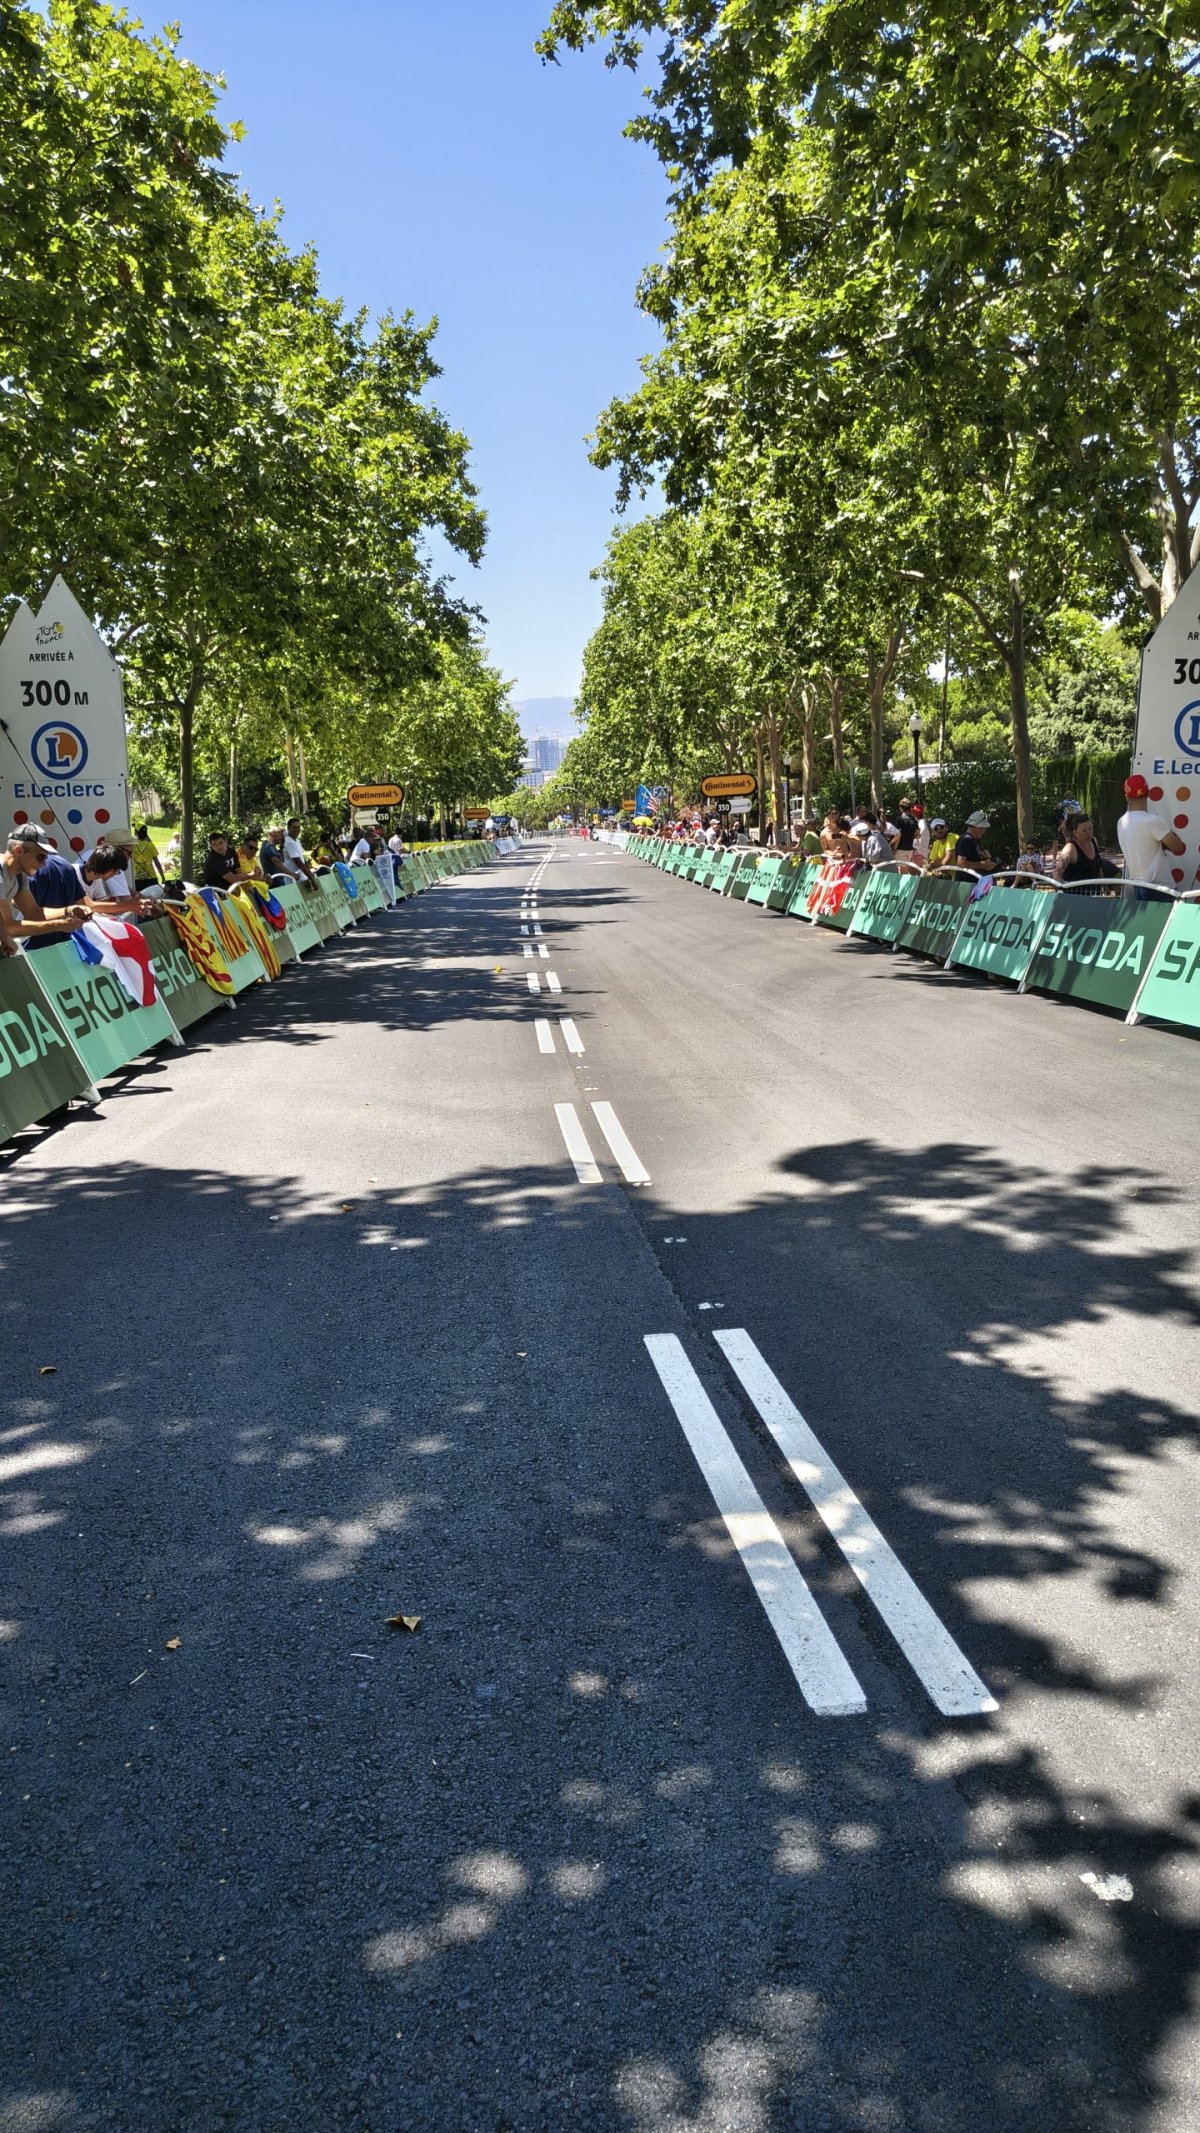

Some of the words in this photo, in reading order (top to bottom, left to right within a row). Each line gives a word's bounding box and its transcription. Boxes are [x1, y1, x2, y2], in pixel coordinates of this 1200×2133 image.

[20, 680, 71, 707] 300
[74, 692, 89, 706] M
[14, 783, 105, 798] E.Leclerc
[705, 781, 746, 791] Continental
[352, 791, 392, 801] Continental
[718, 803, 730, 811] 350
[377, 813, 390, 821] 350
